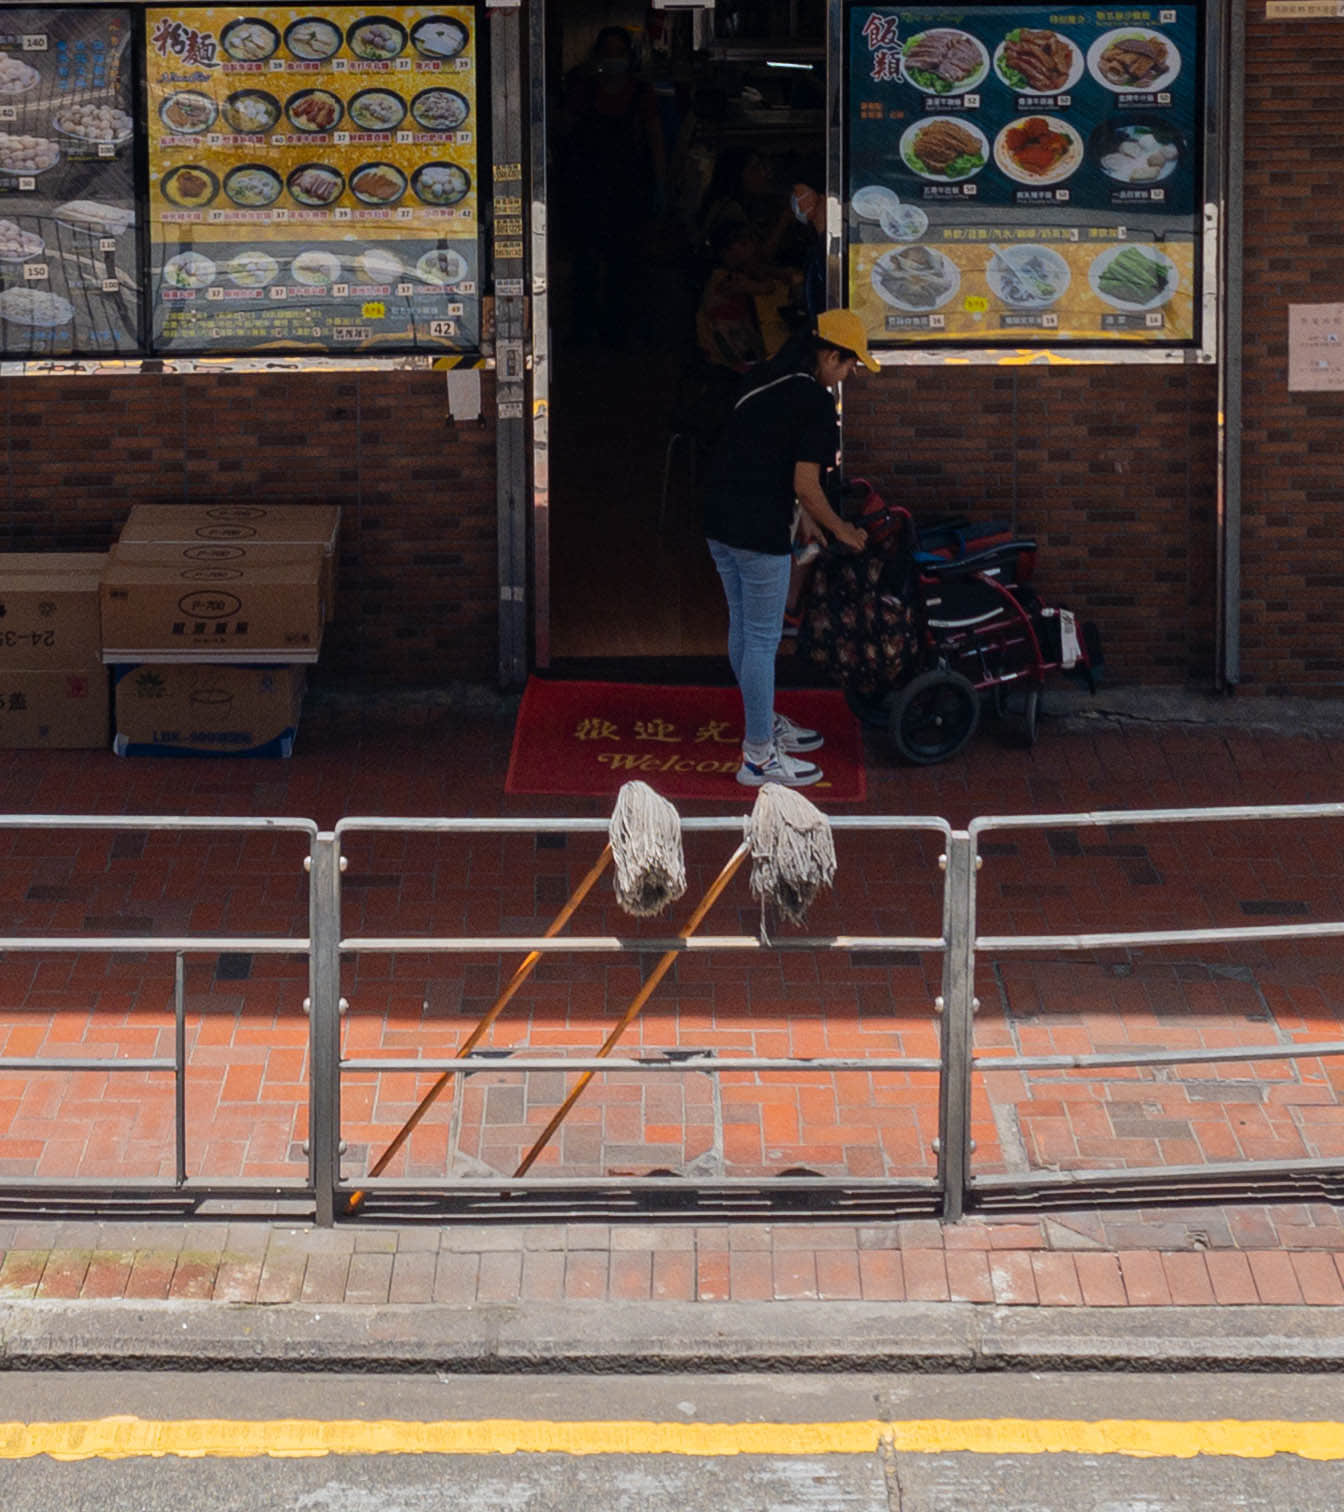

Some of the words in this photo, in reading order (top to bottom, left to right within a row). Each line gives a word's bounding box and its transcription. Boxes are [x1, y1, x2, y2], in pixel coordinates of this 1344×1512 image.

[26, 39, 45, 47] 140
[152, 18, 221, 68] 粉麵
[862, 13, 905, 84] 飯類
[27, 268, 46, 276] 150
[433, 322, 451, 335] 42
[574, 717, 740, 743] 歡迎光
